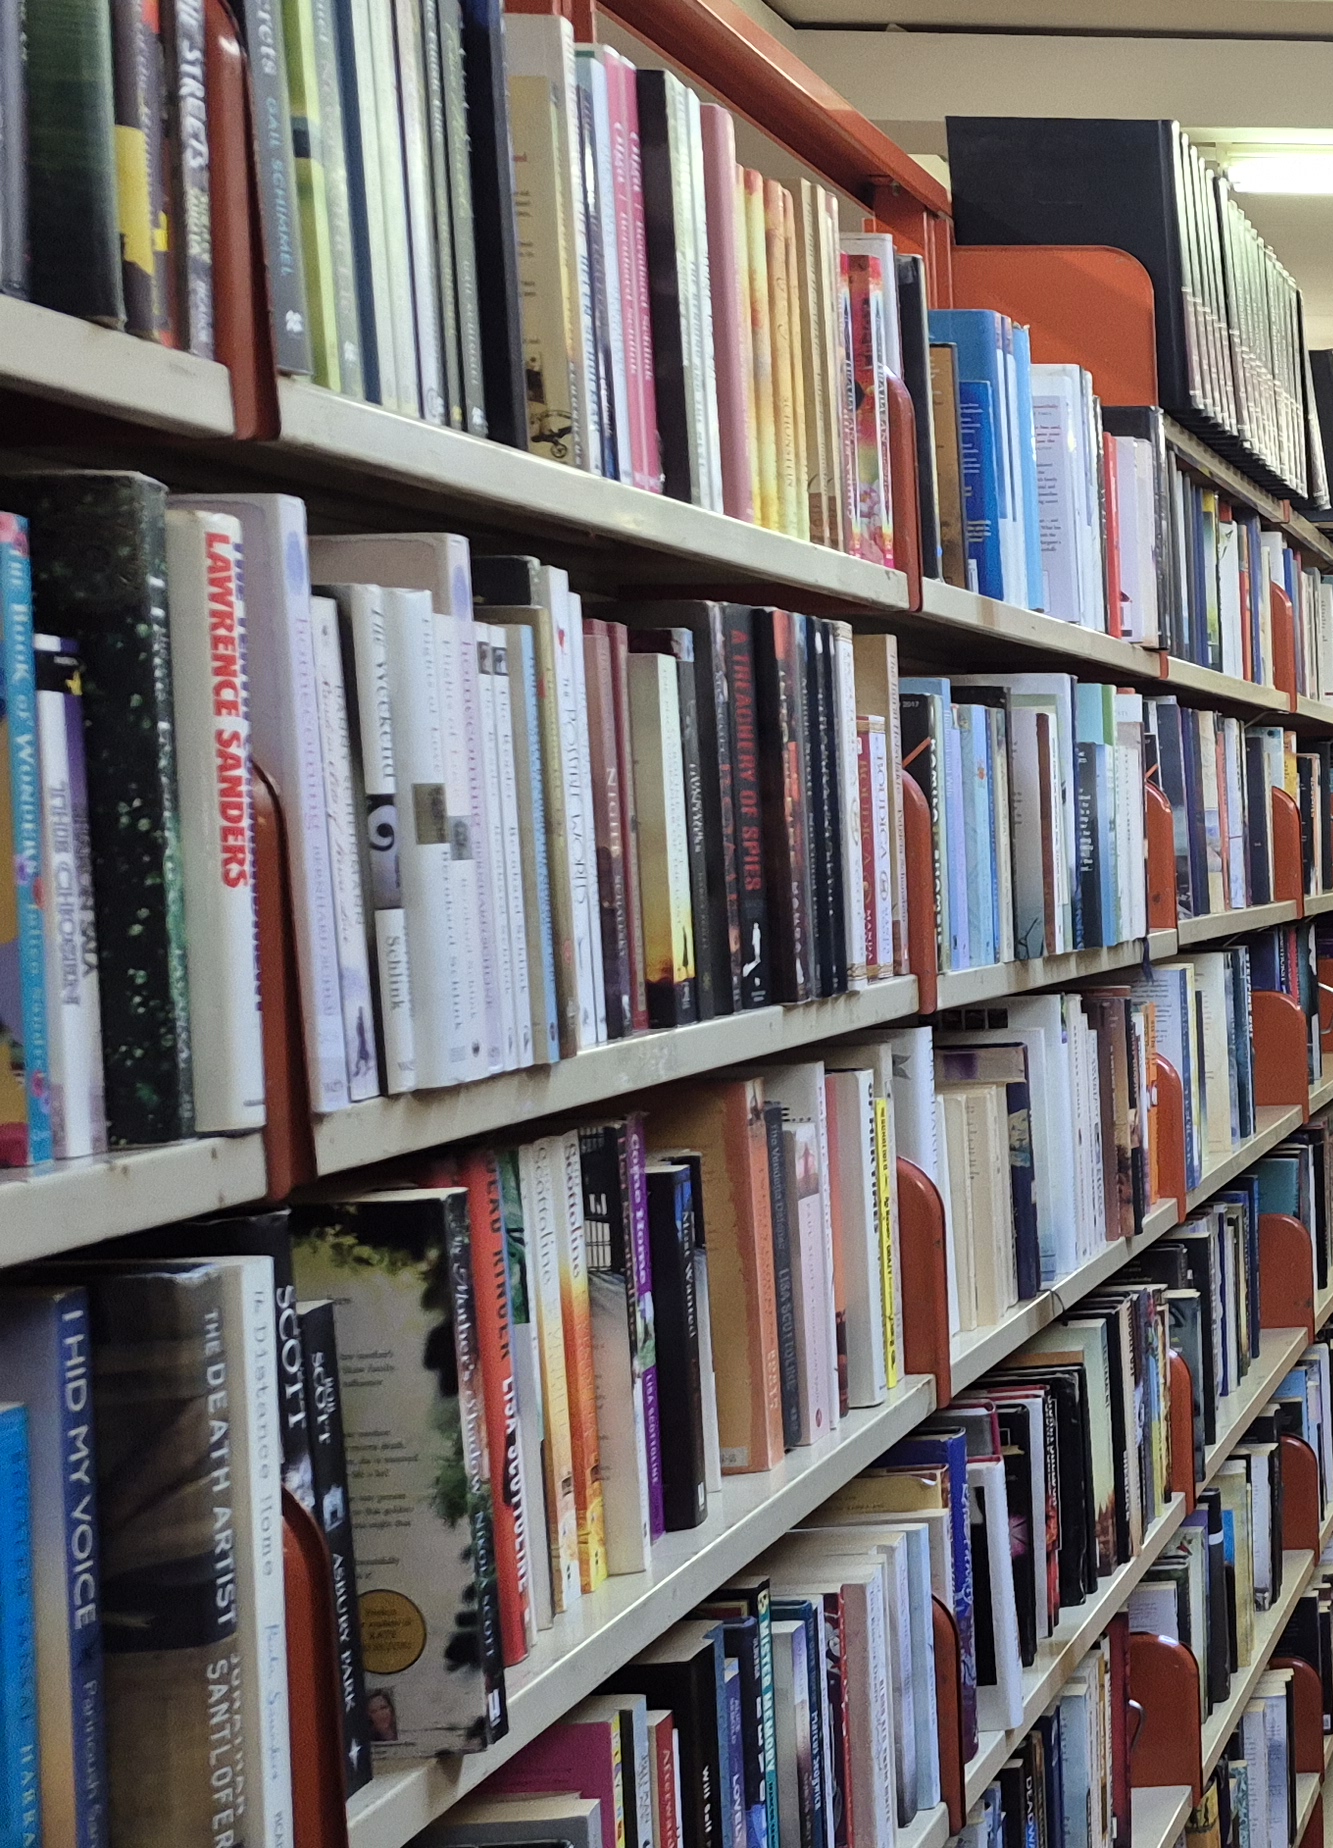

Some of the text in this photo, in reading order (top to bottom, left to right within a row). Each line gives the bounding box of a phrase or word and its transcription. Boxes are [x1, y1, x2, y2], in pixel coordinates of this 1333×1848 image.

[206, 532, 249, 889] LAWRENCE SANDERS
[374, 661, 395, 780] Weekend
[732, 630, 761, 892] A TREACHERY OF SPIES
[563, 1142, 580, 1280] Scottoline
[630, 1133, 650, 1287] Come Home
[682, 1211, 698, 1338] Most Wanted
[779, 1267, 791, 1302] LISA
[254, 1322, 272, 1480] Distance
[278, 1284, 309, 1429] SCOTT
[493, 1249, 517, 1429] RINGER LISA
[645, 1373, 655, 1409] LISA
[62, 1308, 98, 1632] I HID MY VOICE
[204, 1308, 237, 1627] THE DEATH ARTIST
[332, 1553, 355, 1711] ASBURY PARK
